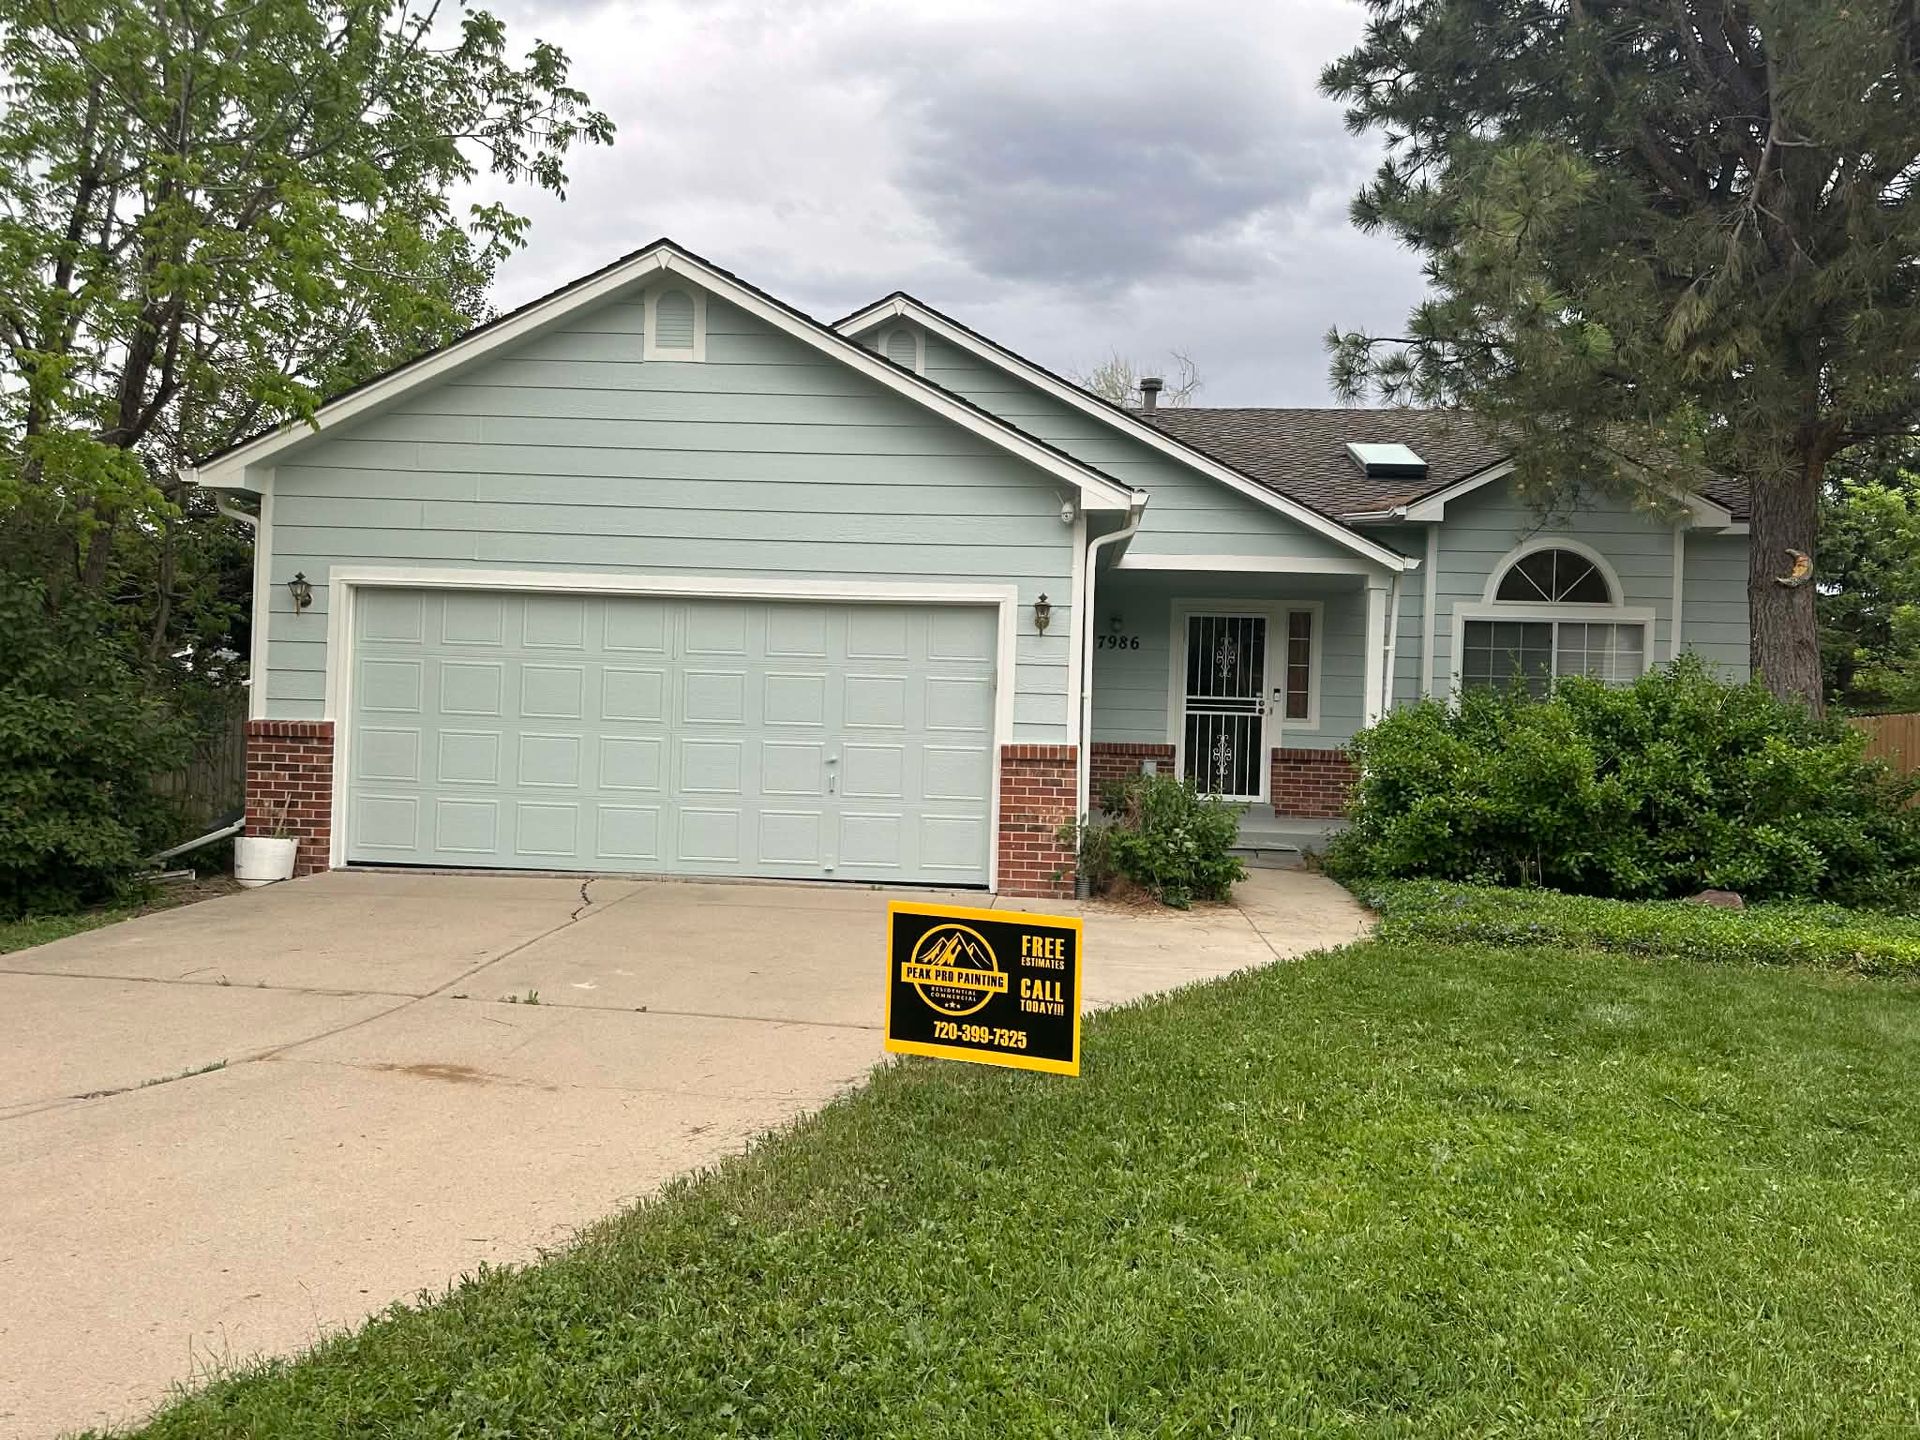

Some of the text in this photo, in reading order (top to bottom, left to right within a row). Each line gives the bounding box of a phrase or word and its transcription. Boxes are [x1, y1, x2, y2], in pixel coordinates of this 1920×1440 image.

[1097, 635, 1140, 650] 7986
[1021, 935, 1065, 960] FREE
[1021, 957, 1065, 970] ESTIMATES
[906, 966, 1004, 988] PEAK PRO PAINTING
[930, 992, 976, 1002] COMMERCIAL
[931, 986, 976, 996] RESIDENTIAL
[1020, 978, 1063, 1003] CALL
[1020, 1000, 1064, 1017] TODAY!!!
[933, 1020, 1027, 1049] 720-399-7325
